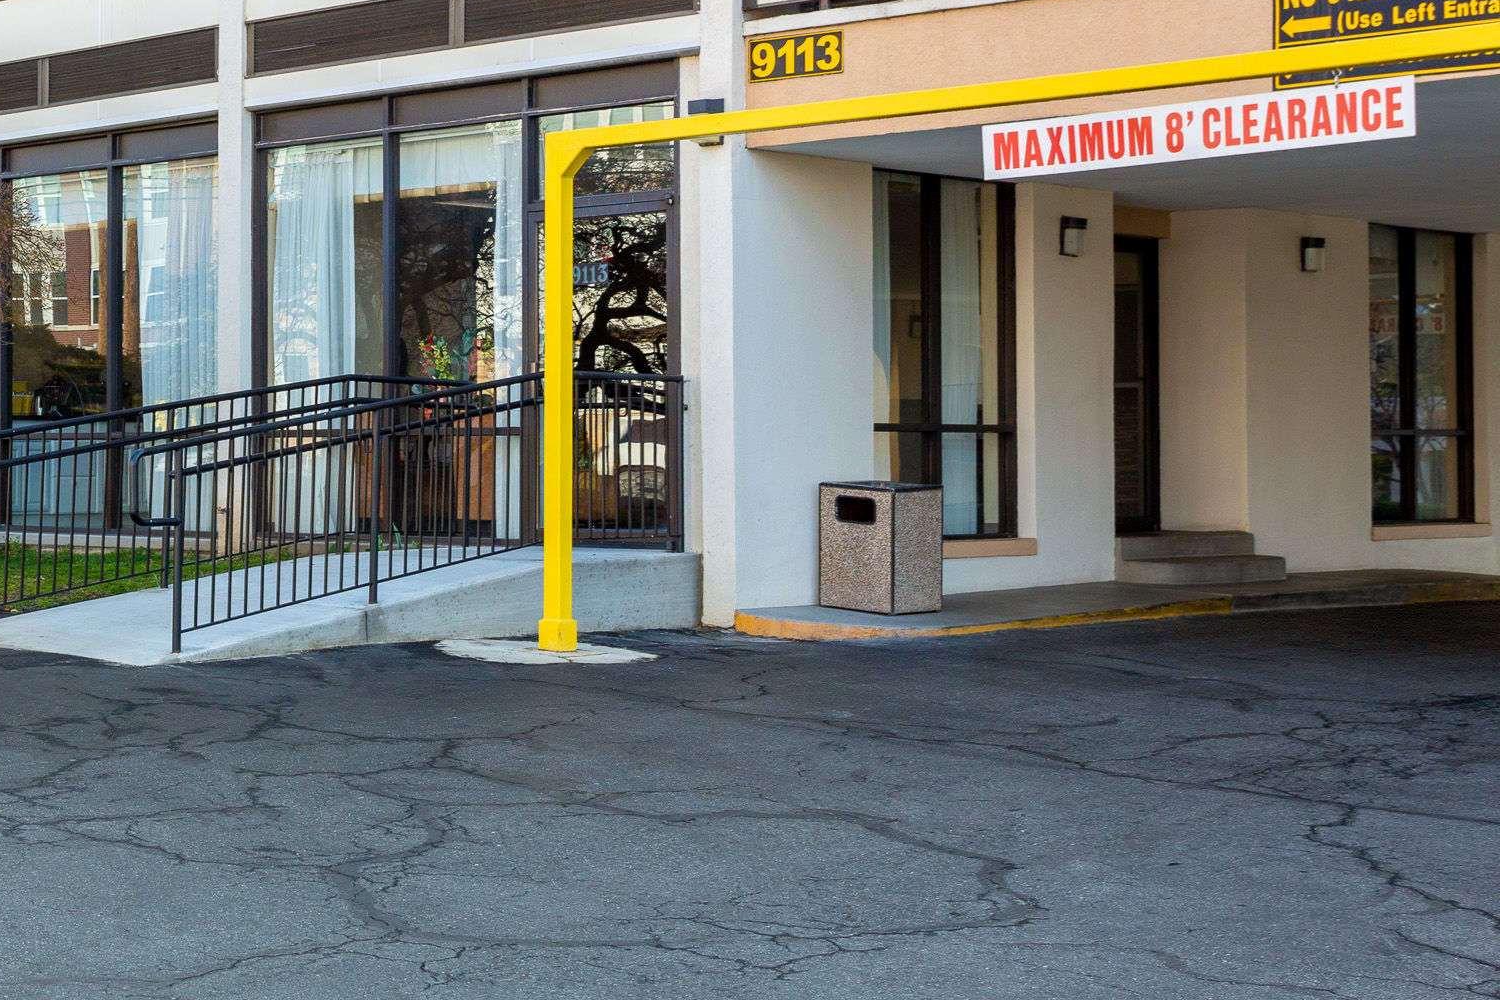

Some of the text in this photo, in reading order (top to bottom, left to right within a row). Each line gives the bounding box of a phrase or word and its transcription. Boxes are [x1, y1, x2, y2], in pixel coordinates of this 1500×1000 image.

[1337, 10, 1383, 34] (Use
[1392, 2, 1436, 25] Left
[751, 34, 841, 78] 9113
[993, 86, 1405, 171] MAXIMUM 8' CLEARANCE
